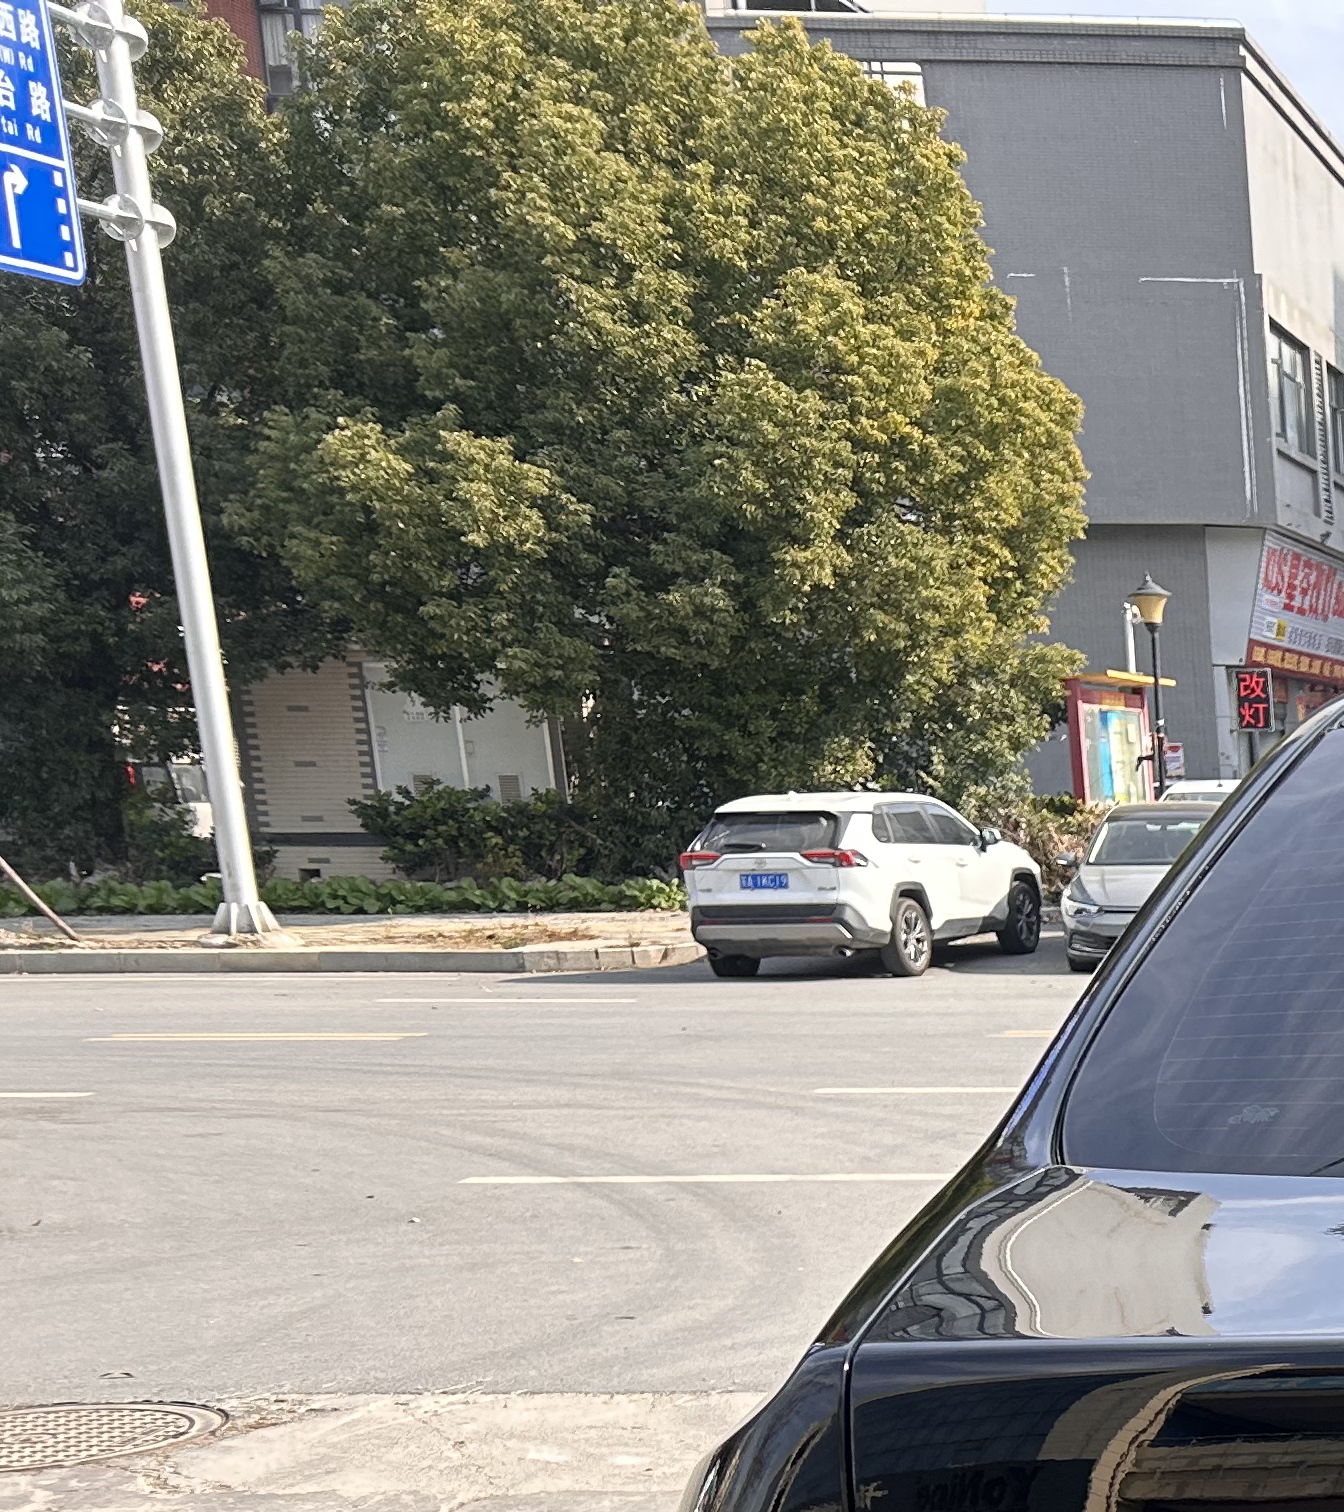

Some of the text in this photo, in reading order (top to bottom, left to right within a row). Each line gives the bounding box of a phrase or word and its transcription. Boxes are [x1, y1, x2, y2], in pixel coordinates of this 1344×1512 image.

[18, 51, 34, 72] Rd
[26, 122, 42, 144] Rd
[1237, 671, 1267, 728] 改灯
